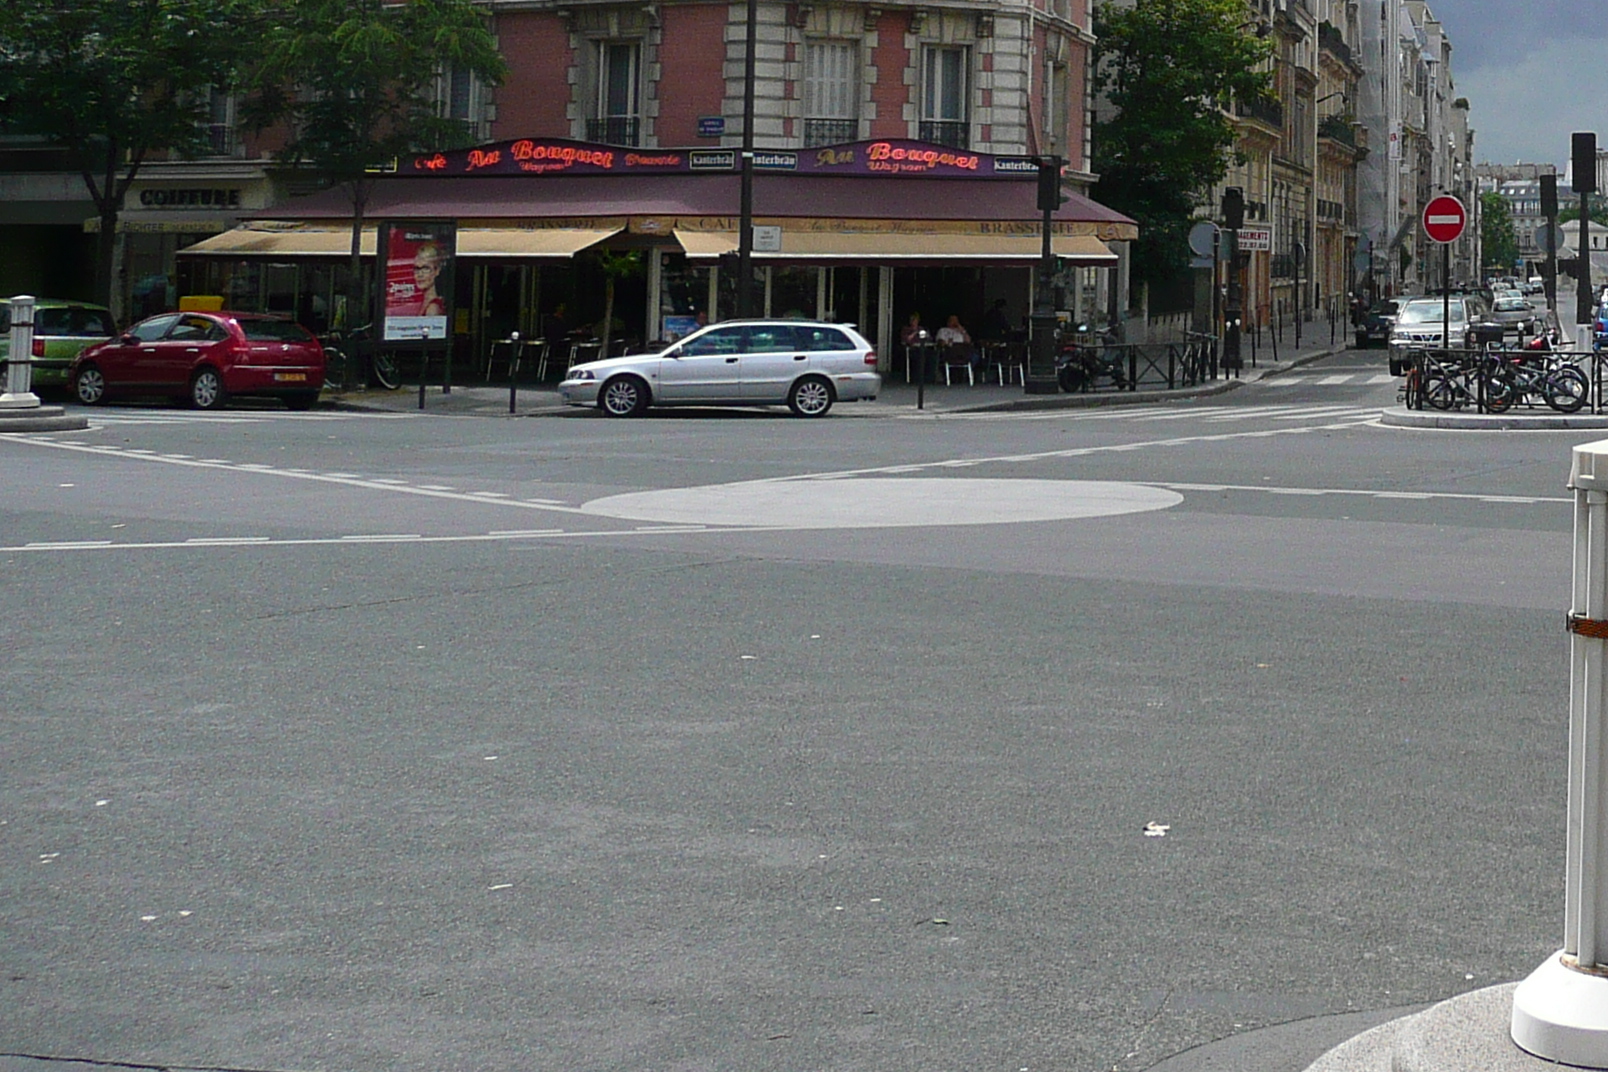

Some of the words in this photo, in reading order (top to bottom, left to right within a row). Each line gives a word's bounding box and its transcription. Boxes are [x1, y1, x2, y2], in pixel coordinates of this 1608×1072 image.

[511, 139, 614, 169] Bouquet
[866, 142, 979, 170] Bouquet
[140, 189, 242, 206] COIFFURE
